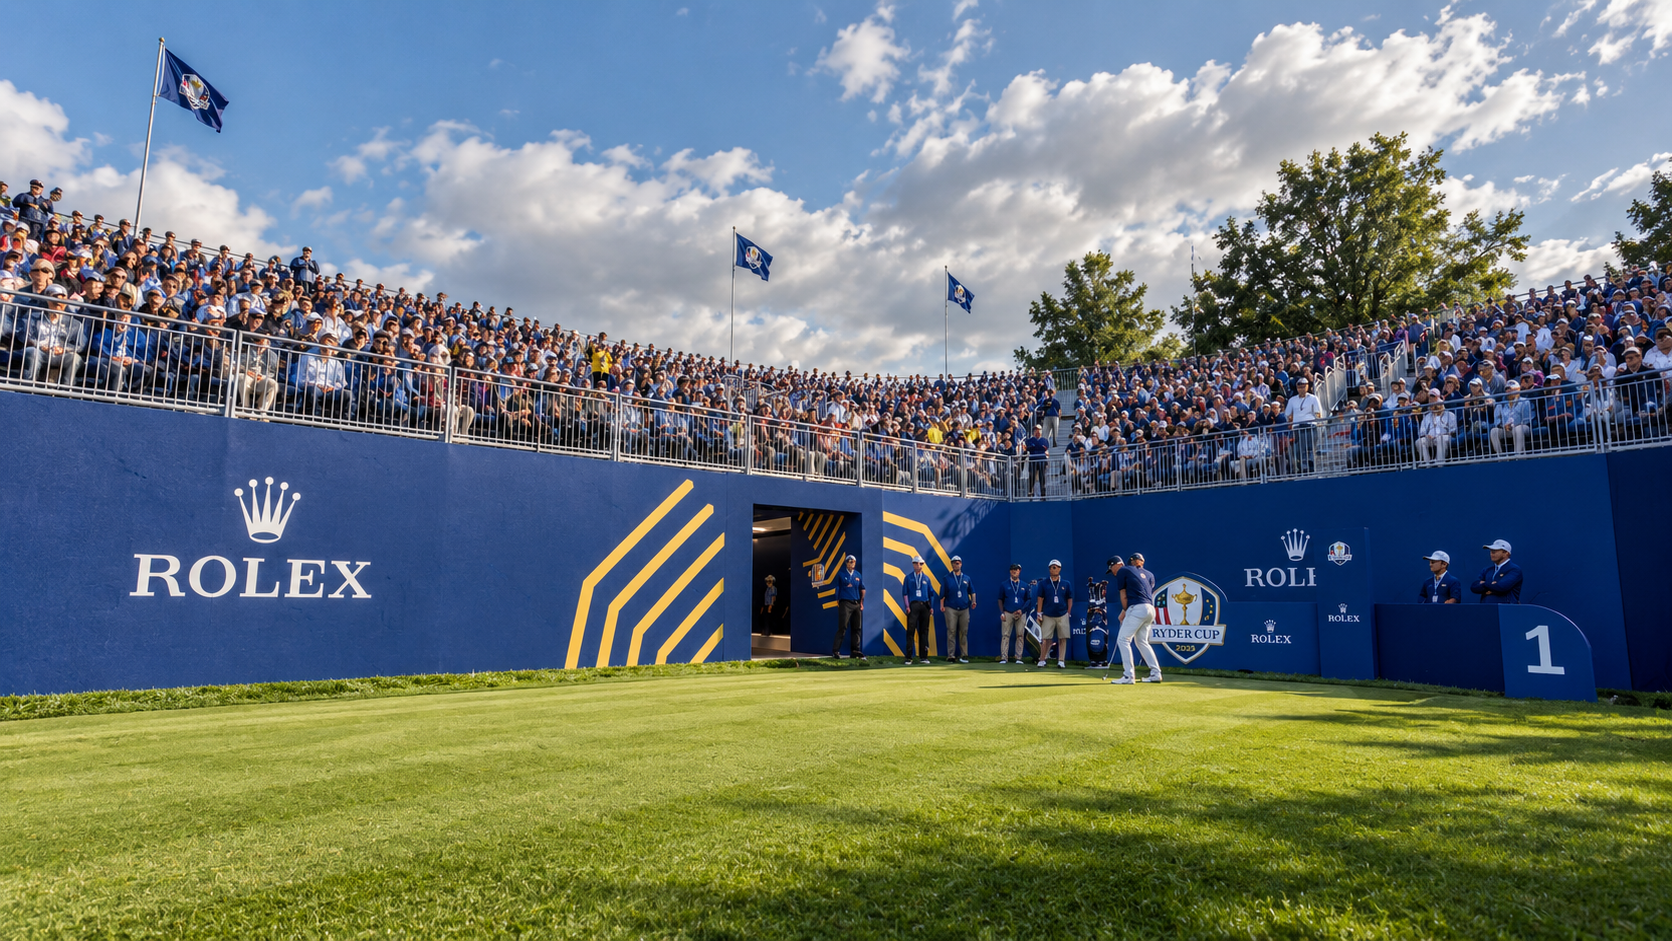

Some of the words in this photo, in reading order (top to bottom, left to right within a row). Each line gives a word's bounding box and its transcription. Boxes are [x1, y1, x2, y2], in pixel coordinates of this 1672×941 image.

[129, 553, 372, 599] ROLEX
[1328, 614, 1360, 623] ROLEX
[1152, 628, 1192, 639] RYDER
[1194, 629, 1220, 640] CUP
[1250, 634, 1292, 644] ROLEX
[1525, 625, 1565, 675] 1
